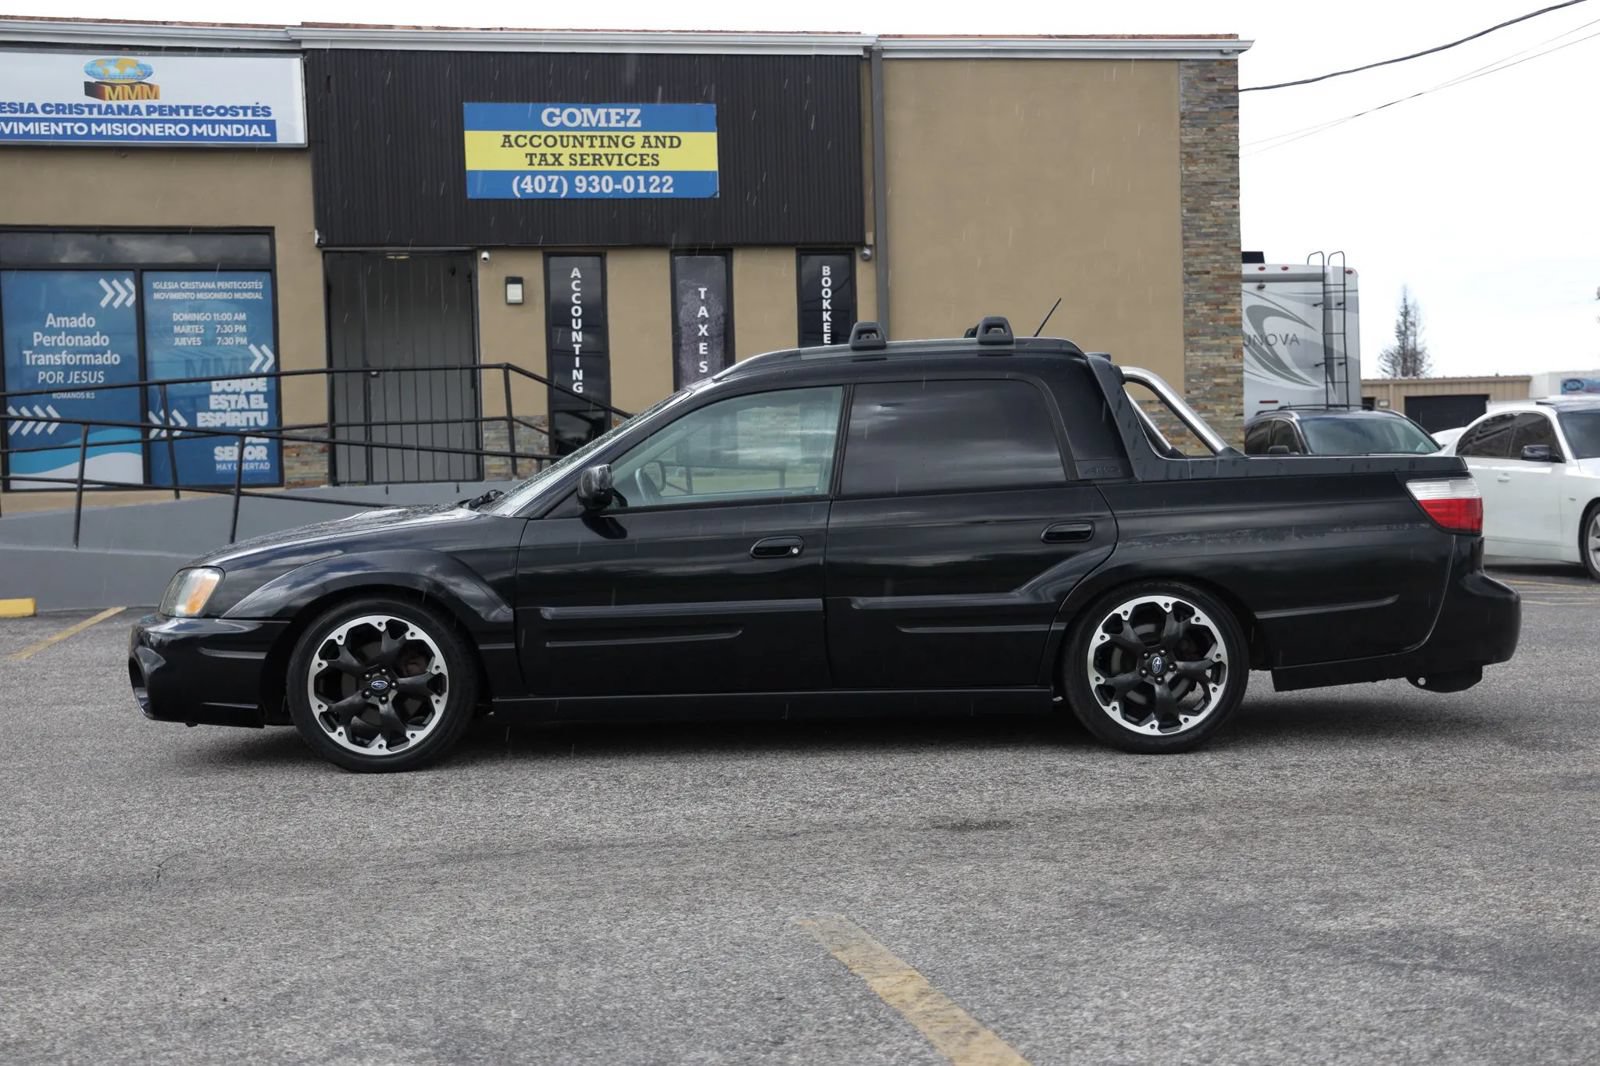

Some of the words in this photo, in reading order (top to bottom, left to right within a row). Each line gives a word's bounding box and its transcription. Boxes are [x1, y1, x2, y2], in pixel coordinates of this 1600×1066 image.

[104, 84, 160, 100] MMM
[41, 103, 143, 116] CRISTIANA
[146, 102, 272, 117] PENTECOSTÉS
[541, 108, 642, 128] GOMEZ
[0, 122, 88, 136] VIMIENTO
[91, 123, 190, 136] MISIONERO
[192, 124, 271, 137] MUNDIAL
[501, 135, 636, 149] ACCOUNTING
[641, 136, 682, 149] AND
[525, 153, 564, 167] TAX
[569, 153, 660, 167] SERVICES
[512, 175, 569, 198] (407)
[575, 175, 674, 194] 930-0122
[152, 281, 179, 290] IGLESIA
[180, 281, 215, 290] CRISTIANA
[153, 292, 195, 300] MOVIMIENTO
[196, 292, 233, 300] MISIONERO
[234, 292, 263, 300] MUNDIAL
[821, 265, 832, 345] BOOKKEE
[45, 313, 96, 328] Amado
[172, 313, 211, 321] DOMINGO
[213, 313, 232, 321] 11:00
[233, 312, 247, 321] AM
[173, 325, 204, 334] MARTES
[215, 325, 233, 334] 7:30
[234, 325, 247, 334] PM
[570, 267, 584, 393] ACCOUNTING
[697, 287, 709, 373] TAXES
[33, 332, 109, 346] Perdonado
[174, 337, 202, 346] JUEVES
[216, 337, 234, 346] 7:30
[235, 337, 248, 346] PM
[23, 351, 121, 365] Transformado
[38, 371, 64, 384] POR
[67, 371, 105, 384] JESUS
[212, 377, 267, 393] DONDE
[249, 394, 268, 409] EL
[216, 462, 232, 470] HAY
[233, 462, 270, 470] LBERTAD
